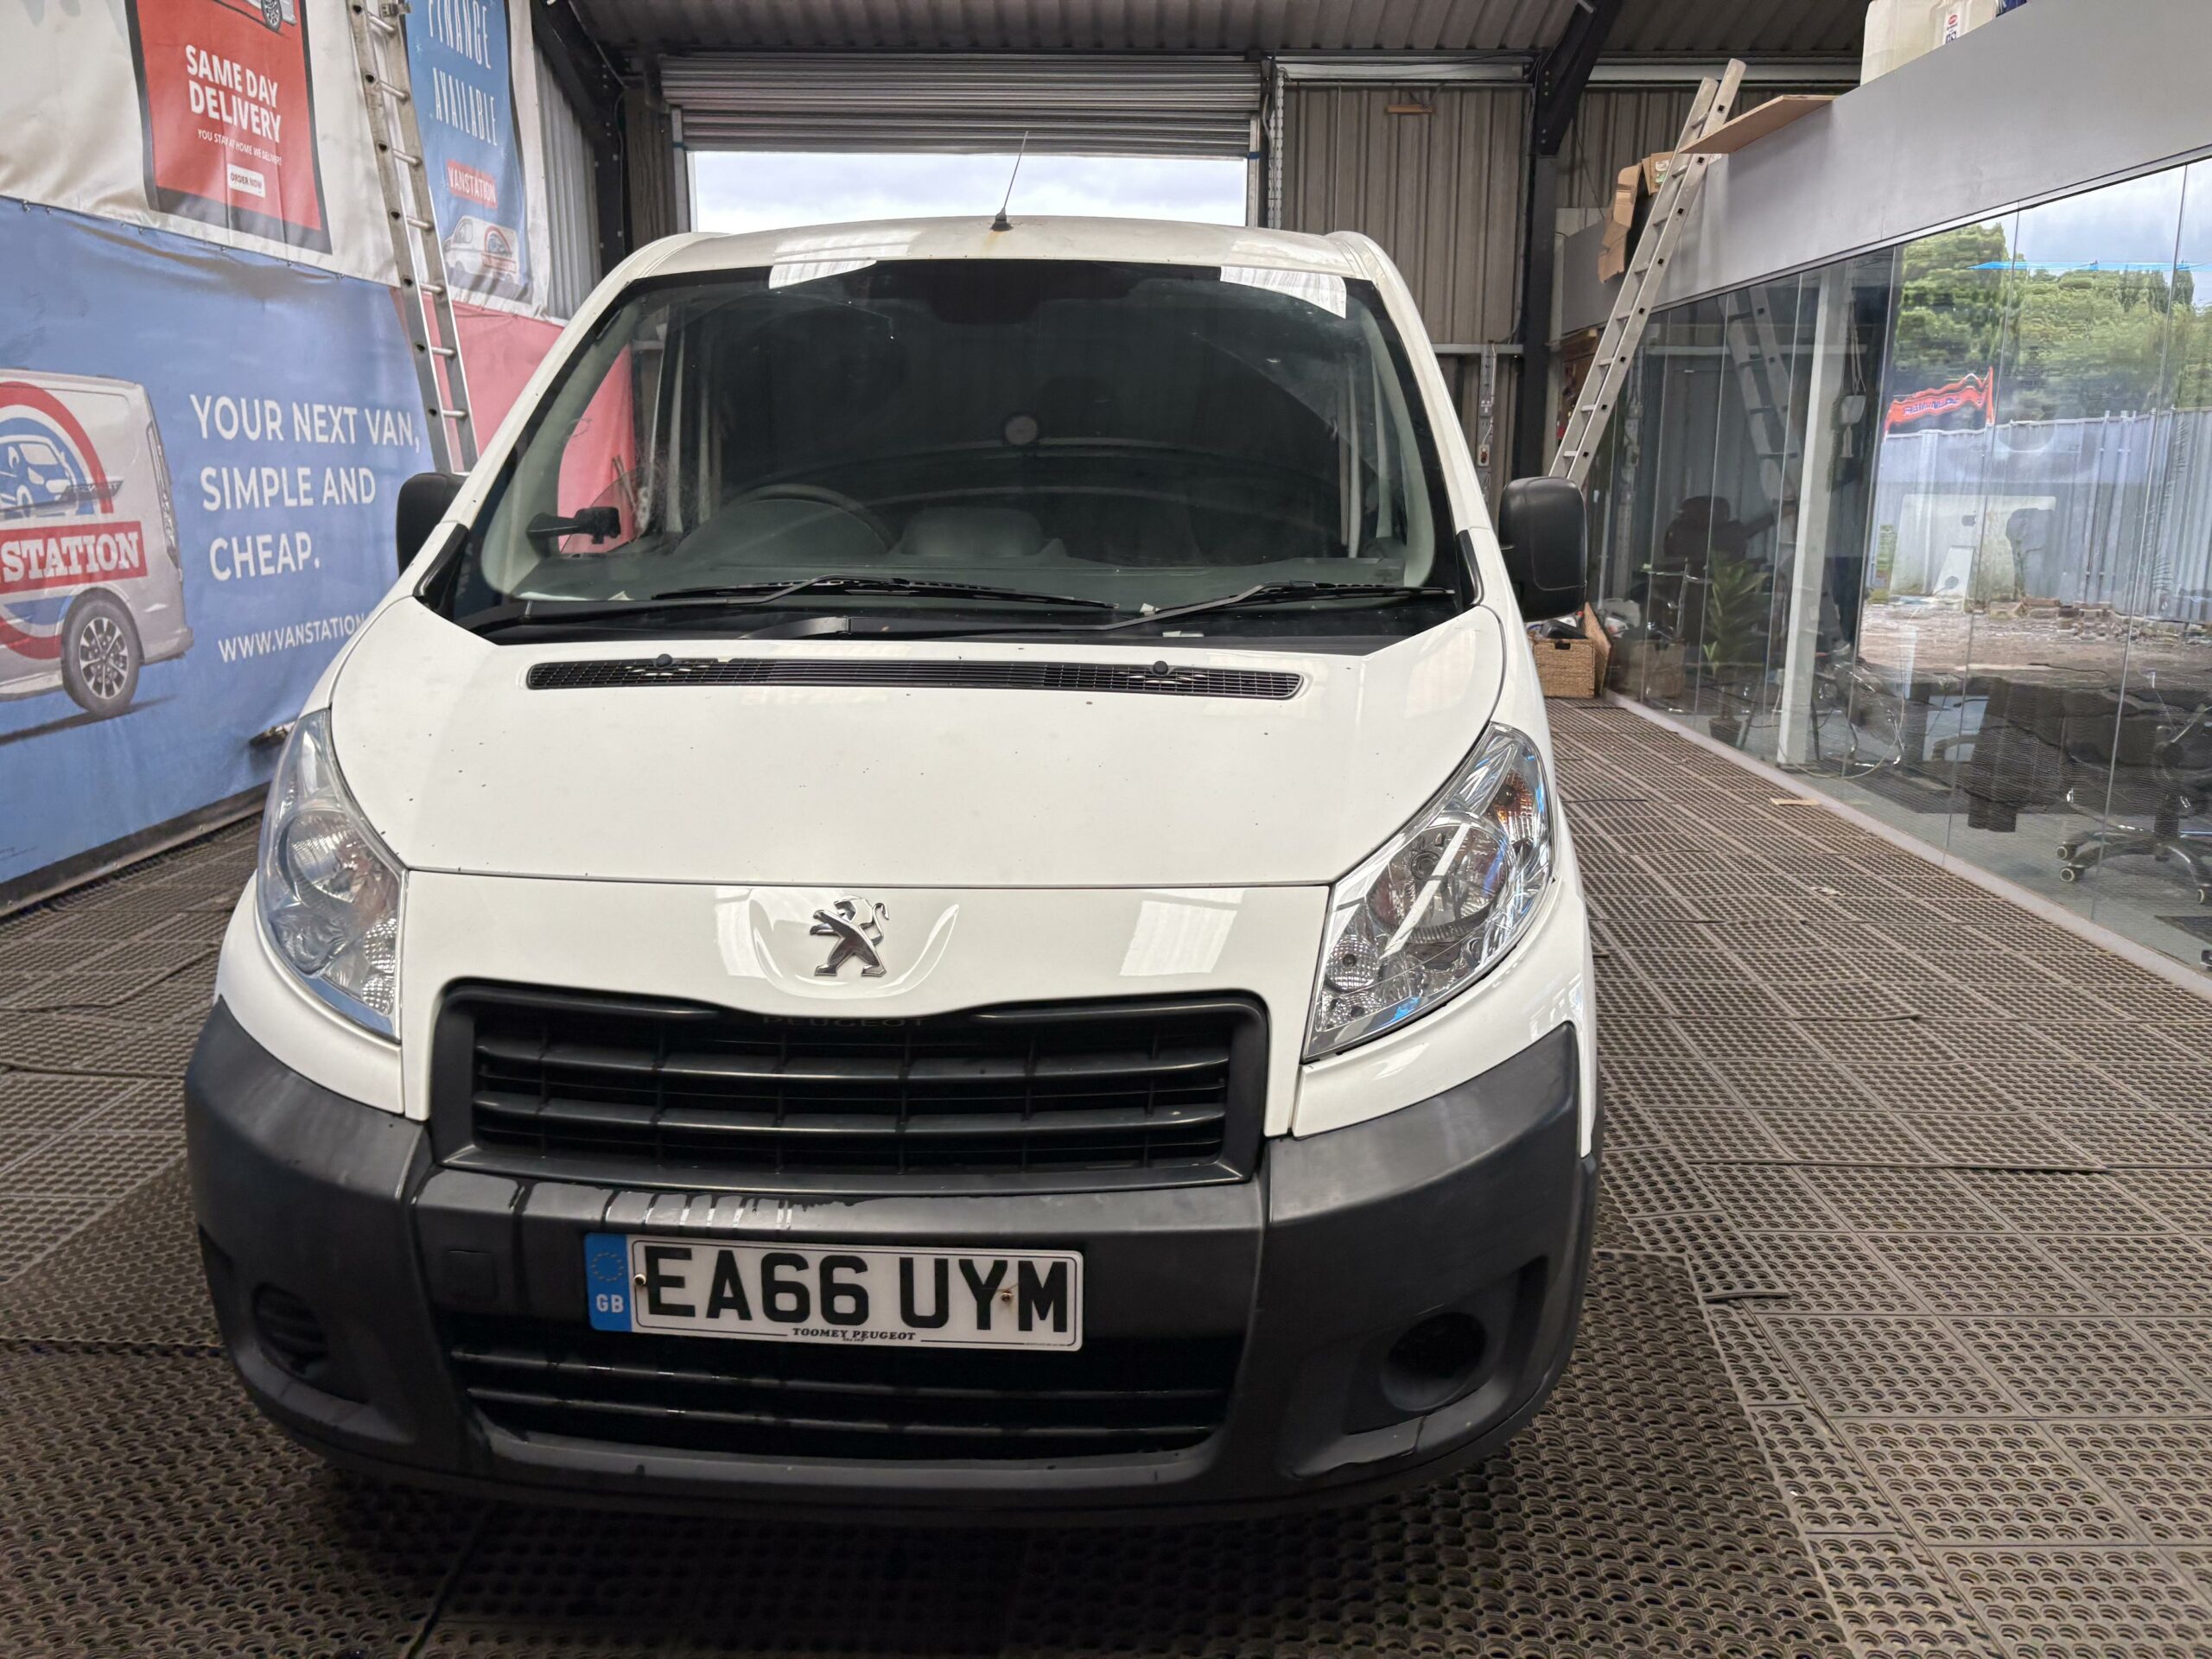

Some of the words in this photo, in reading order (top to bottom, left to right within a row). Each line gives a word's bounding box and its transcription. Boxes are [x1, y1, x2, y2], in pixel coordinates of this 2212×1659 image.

[186, 44, 243, 92] SAME
[245, 68, 278, 108] DAY
[188, 79, 282, 143] DELIVERY
[433, 67, 497, 146] AVAILABLE
[197, 129, 213, 142] YOU
[213, 133, 228, 147] STAY
[235, 142, 252, 156] HOME
[252, 147, 262, 158] WE
[230, 172, 249, 185] ORDER
[249, 177, 263, 189] NOW
[448, 166, 496, 204] VANSTATION
[189, 394, 284, 442] YOUR
[292, 402, 358, 445] NEXT
[365, 408, 420, 454] VAN,
[200, 467, 314, 512] SIMPLE
[322, 467, 376, 505] AND
[1, 531, 139, 582] STATION
[209, 531, 320, 582] CHEAP.
[218, 613, 366, 663] WWW.VANSTATION
[595, 1294, 624, 1313] GB
[644, 1246, 869, 1326] EA66
[899, 1255, 1069, 1333] UYM
[792, 1327, 849, 1338] TOOMEY
[852, 1331, 916, 1341] PEUGEOT
